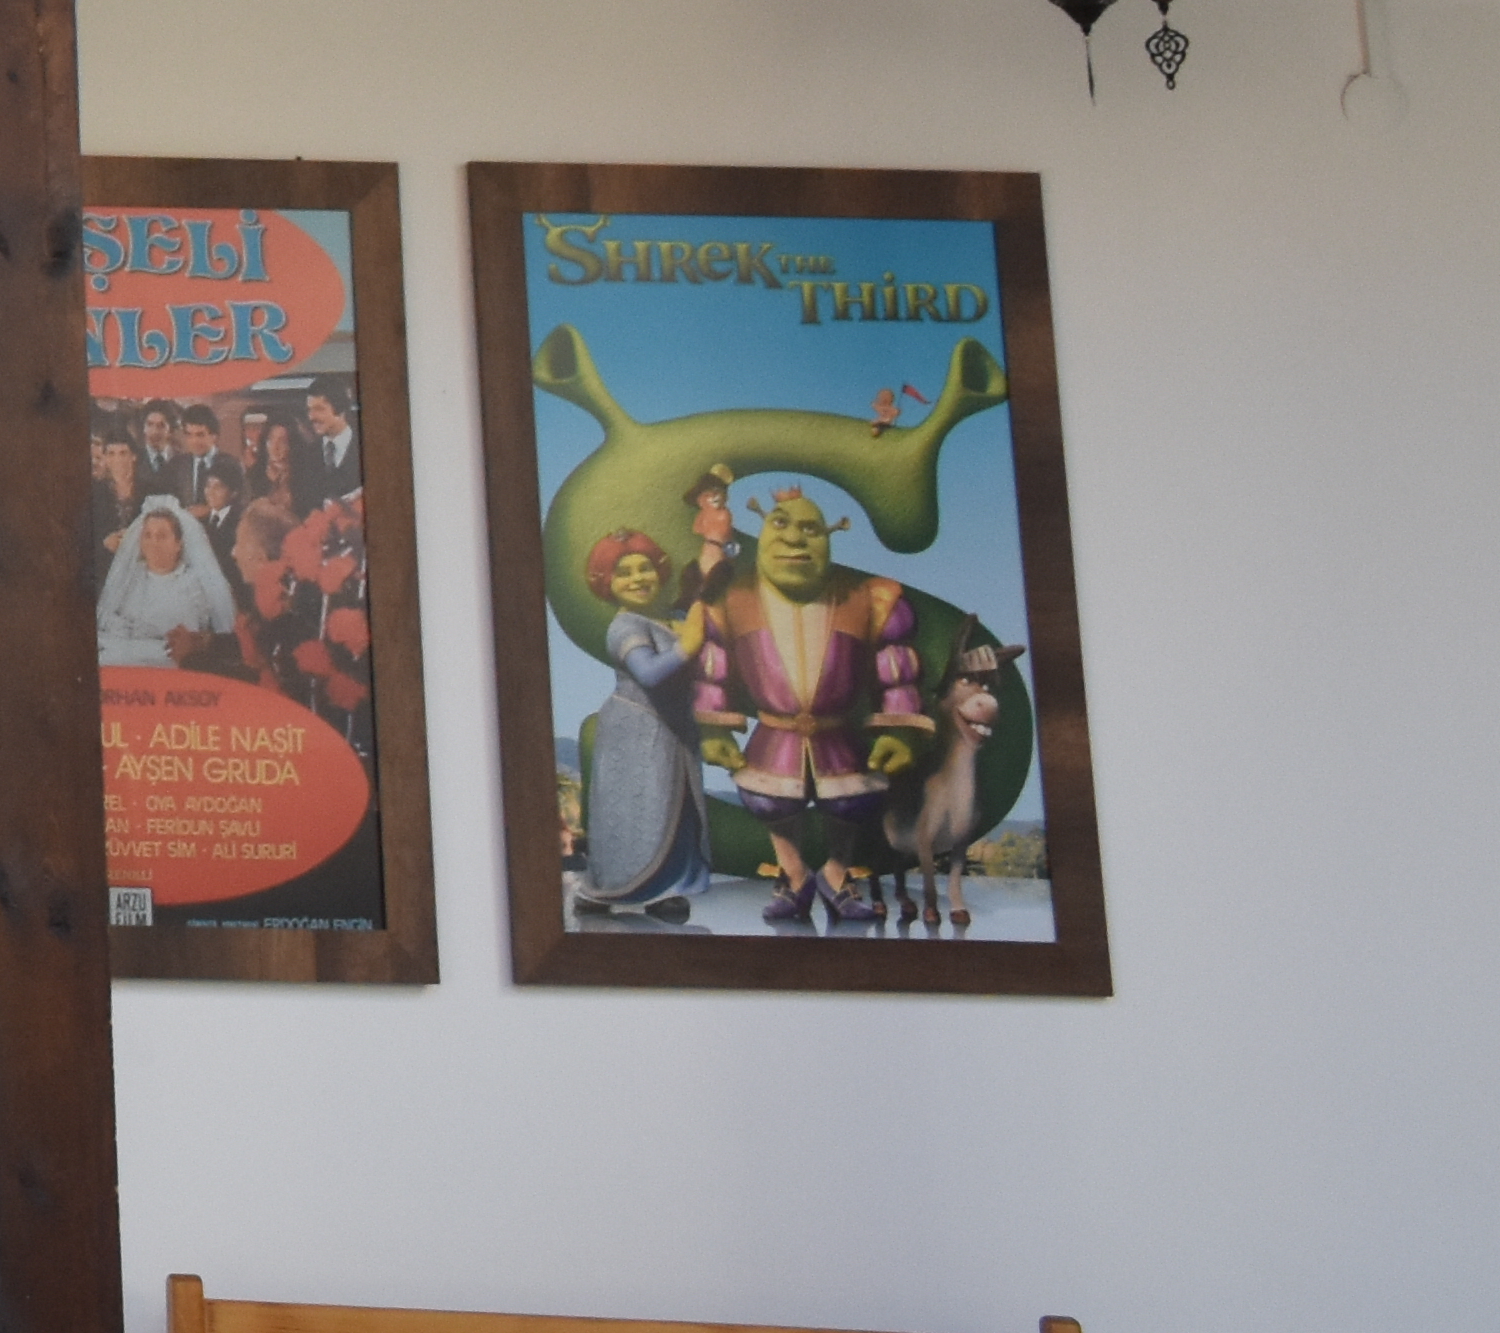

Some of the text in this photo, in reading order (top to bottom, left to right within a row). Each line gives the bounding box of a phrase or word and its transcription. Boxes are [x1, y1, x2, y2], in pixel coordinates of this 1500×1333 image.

[778, 254, 836, 275] THE
[165, 690, 221, 707] AKSOY
[150, 720, 220, 752] ADİLE
[231, 723, 306, 759] NAŞİT
[115, 753, 300, 786] AYŞEN GRUDA
[167, 840, 197, 859] SİM
[115, 892, 146, 910] ARZU
